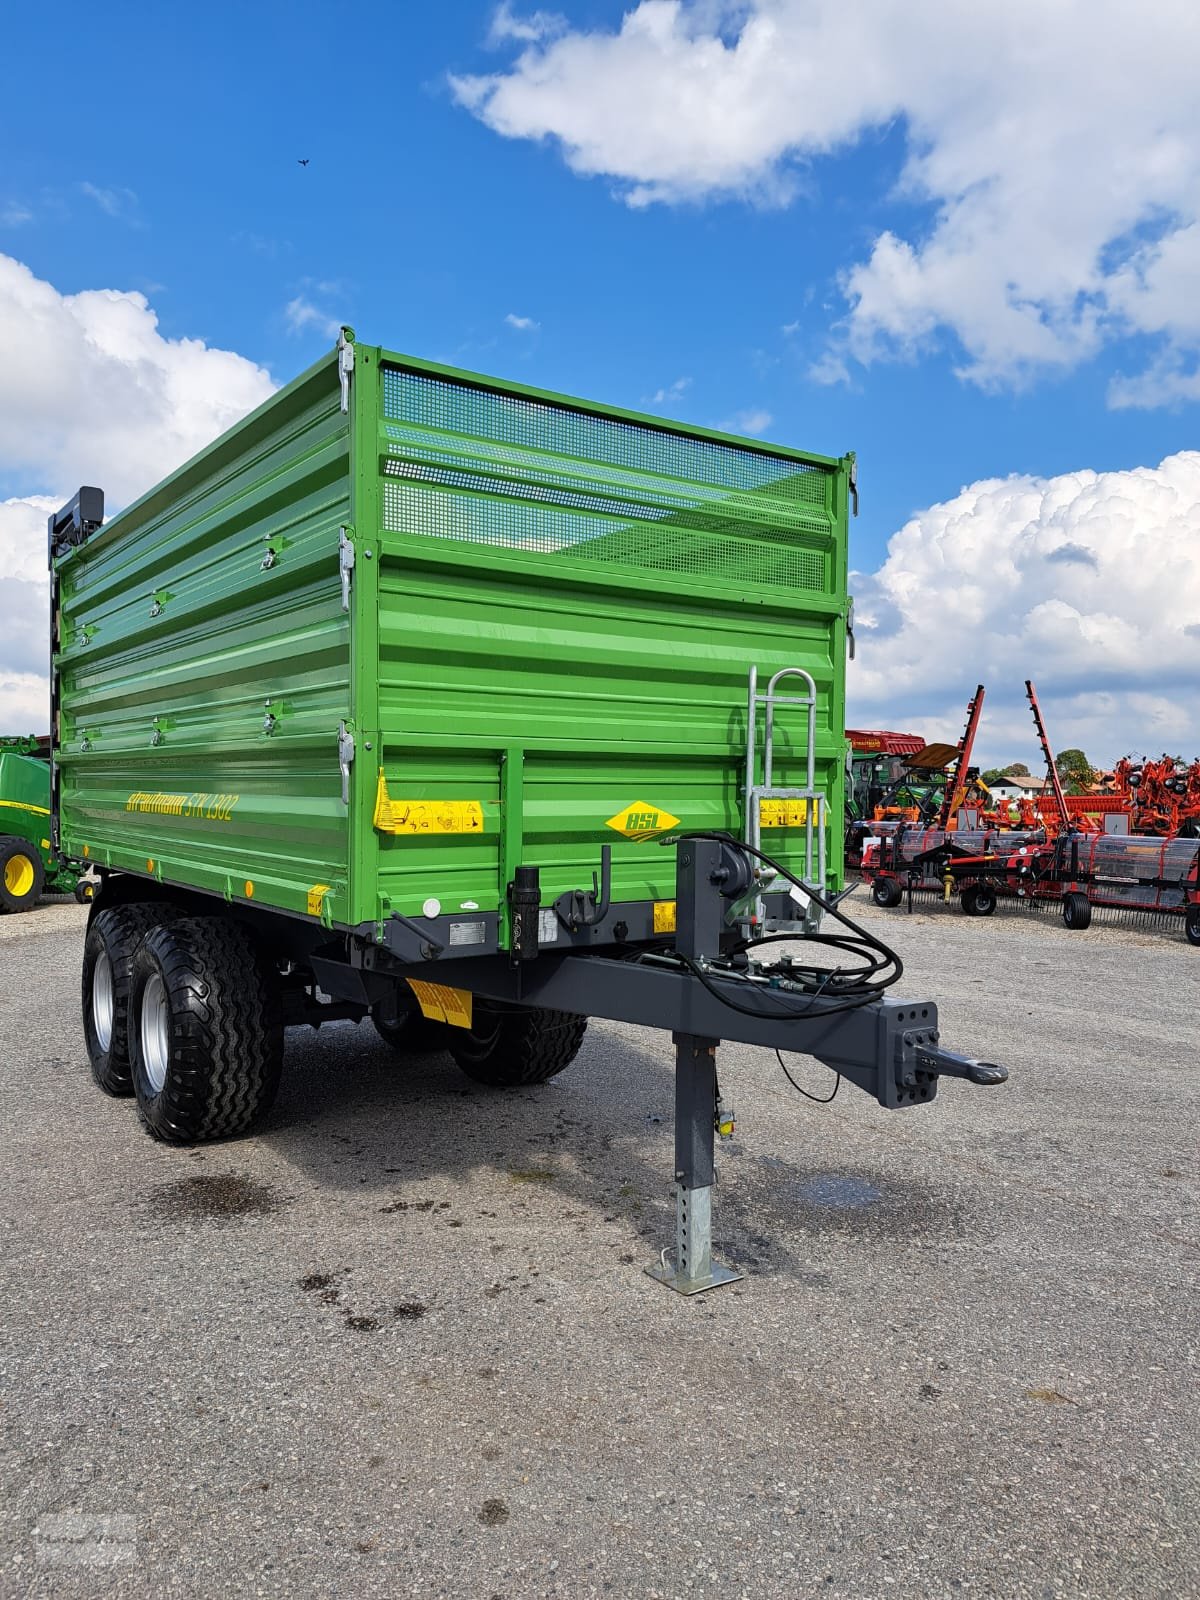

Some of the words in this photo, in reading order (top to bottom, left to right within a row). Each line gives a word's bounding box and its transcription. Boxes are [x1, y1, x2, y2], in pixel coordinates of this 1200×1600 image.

[126, 792, 188, 816] strautmann
[185, 793, 210, 817] STK
[206, 794, 239, 820] 1302
[626, 812, 662, 830] BSL
